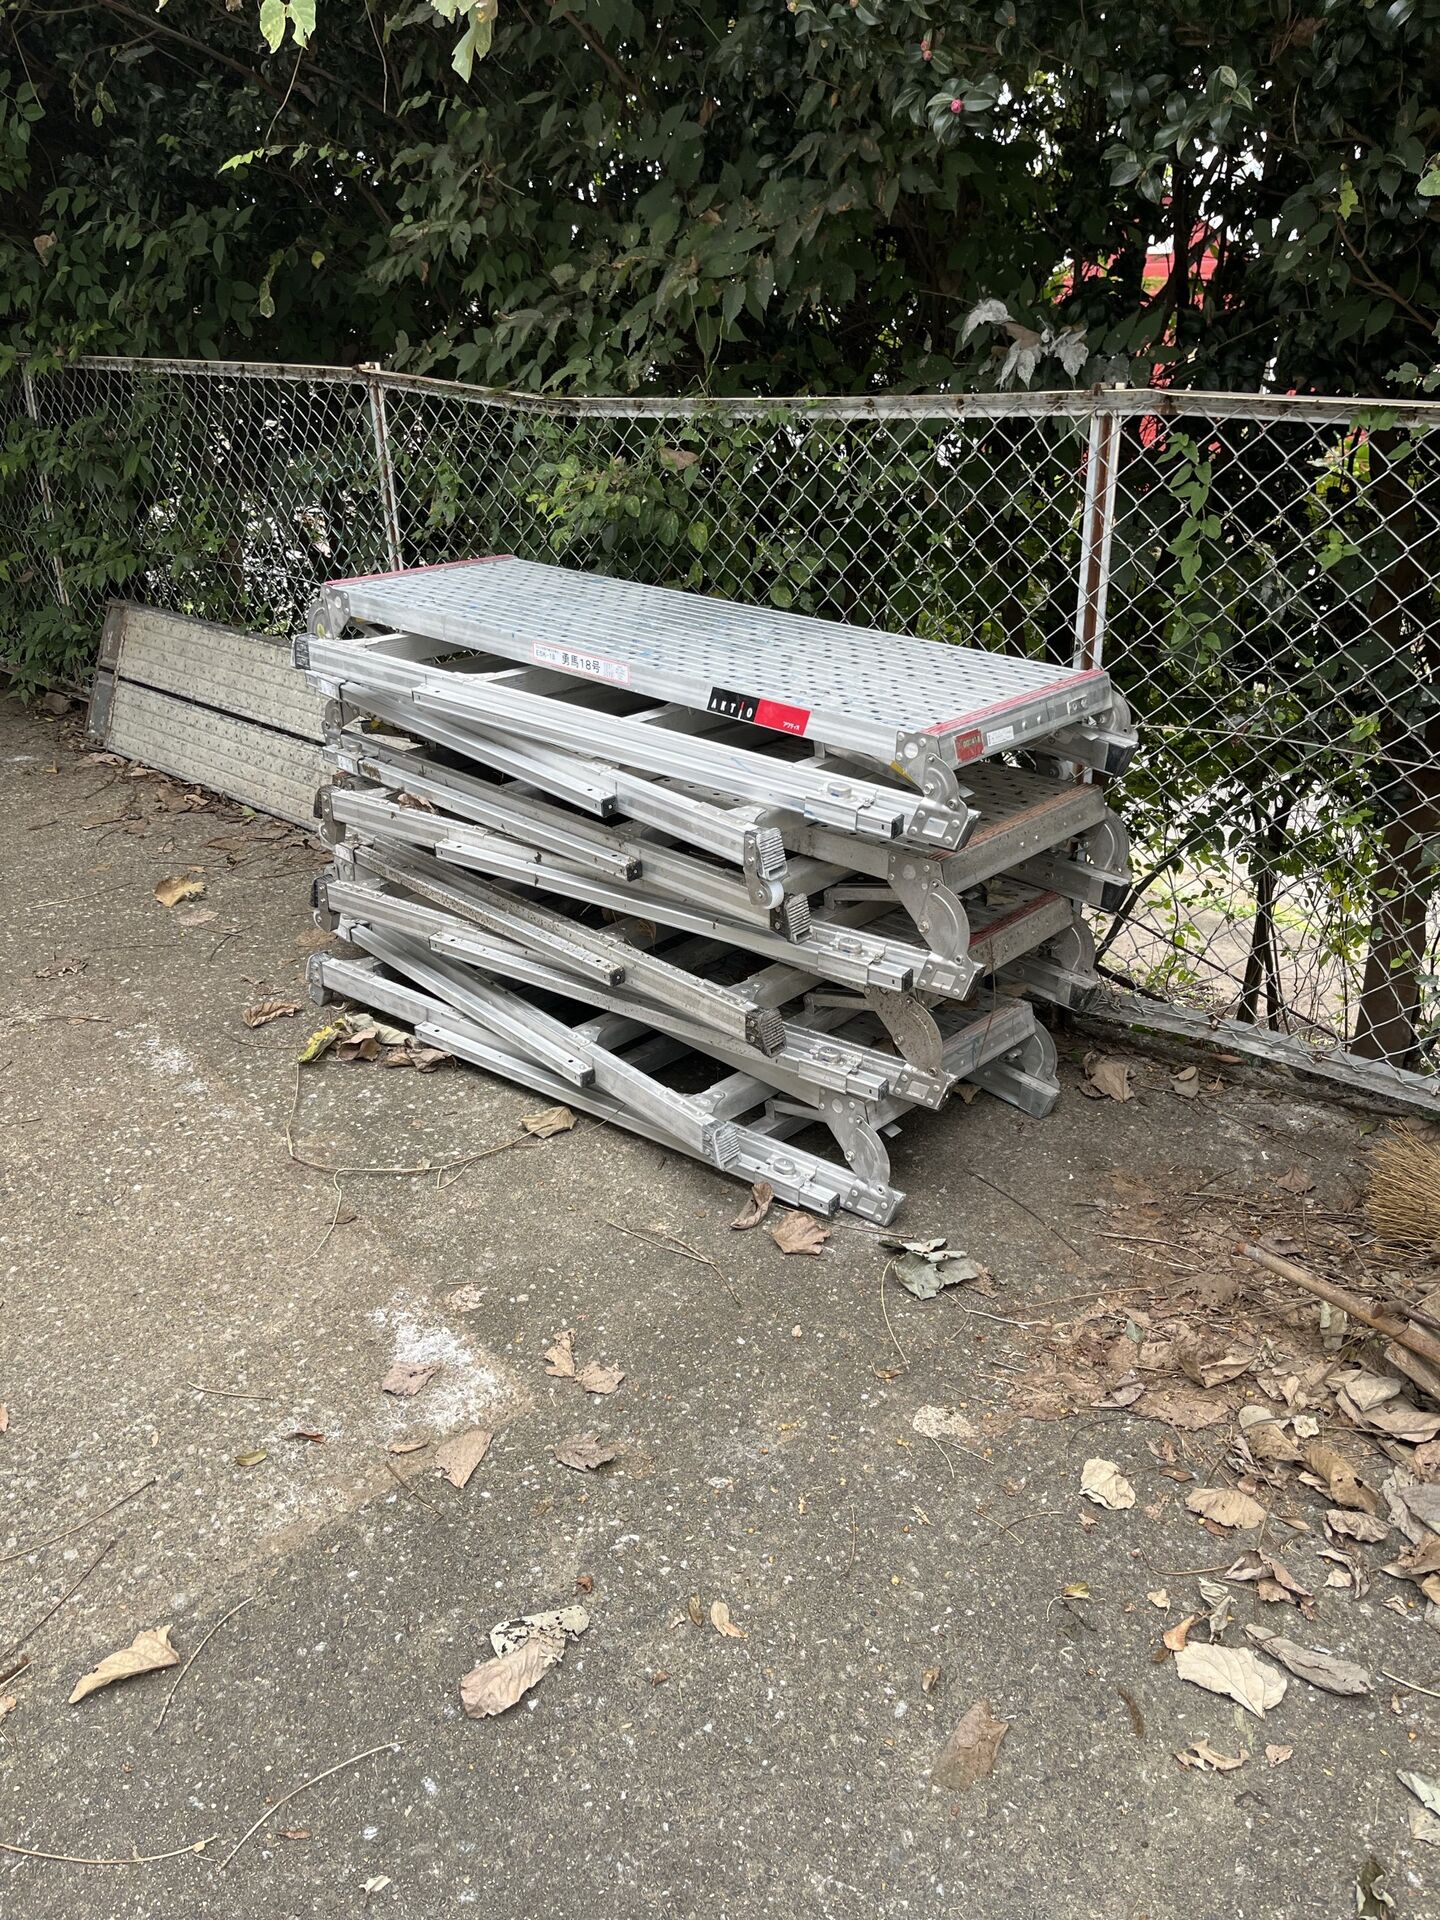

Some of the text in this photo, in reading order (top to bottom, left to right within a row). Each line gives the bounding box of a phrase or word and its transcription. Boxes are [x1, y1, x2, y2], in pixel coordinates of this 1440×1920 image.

[562, 652, 600, 674] 勇馬18号
[711, 698, 753, 719] AKTIO
